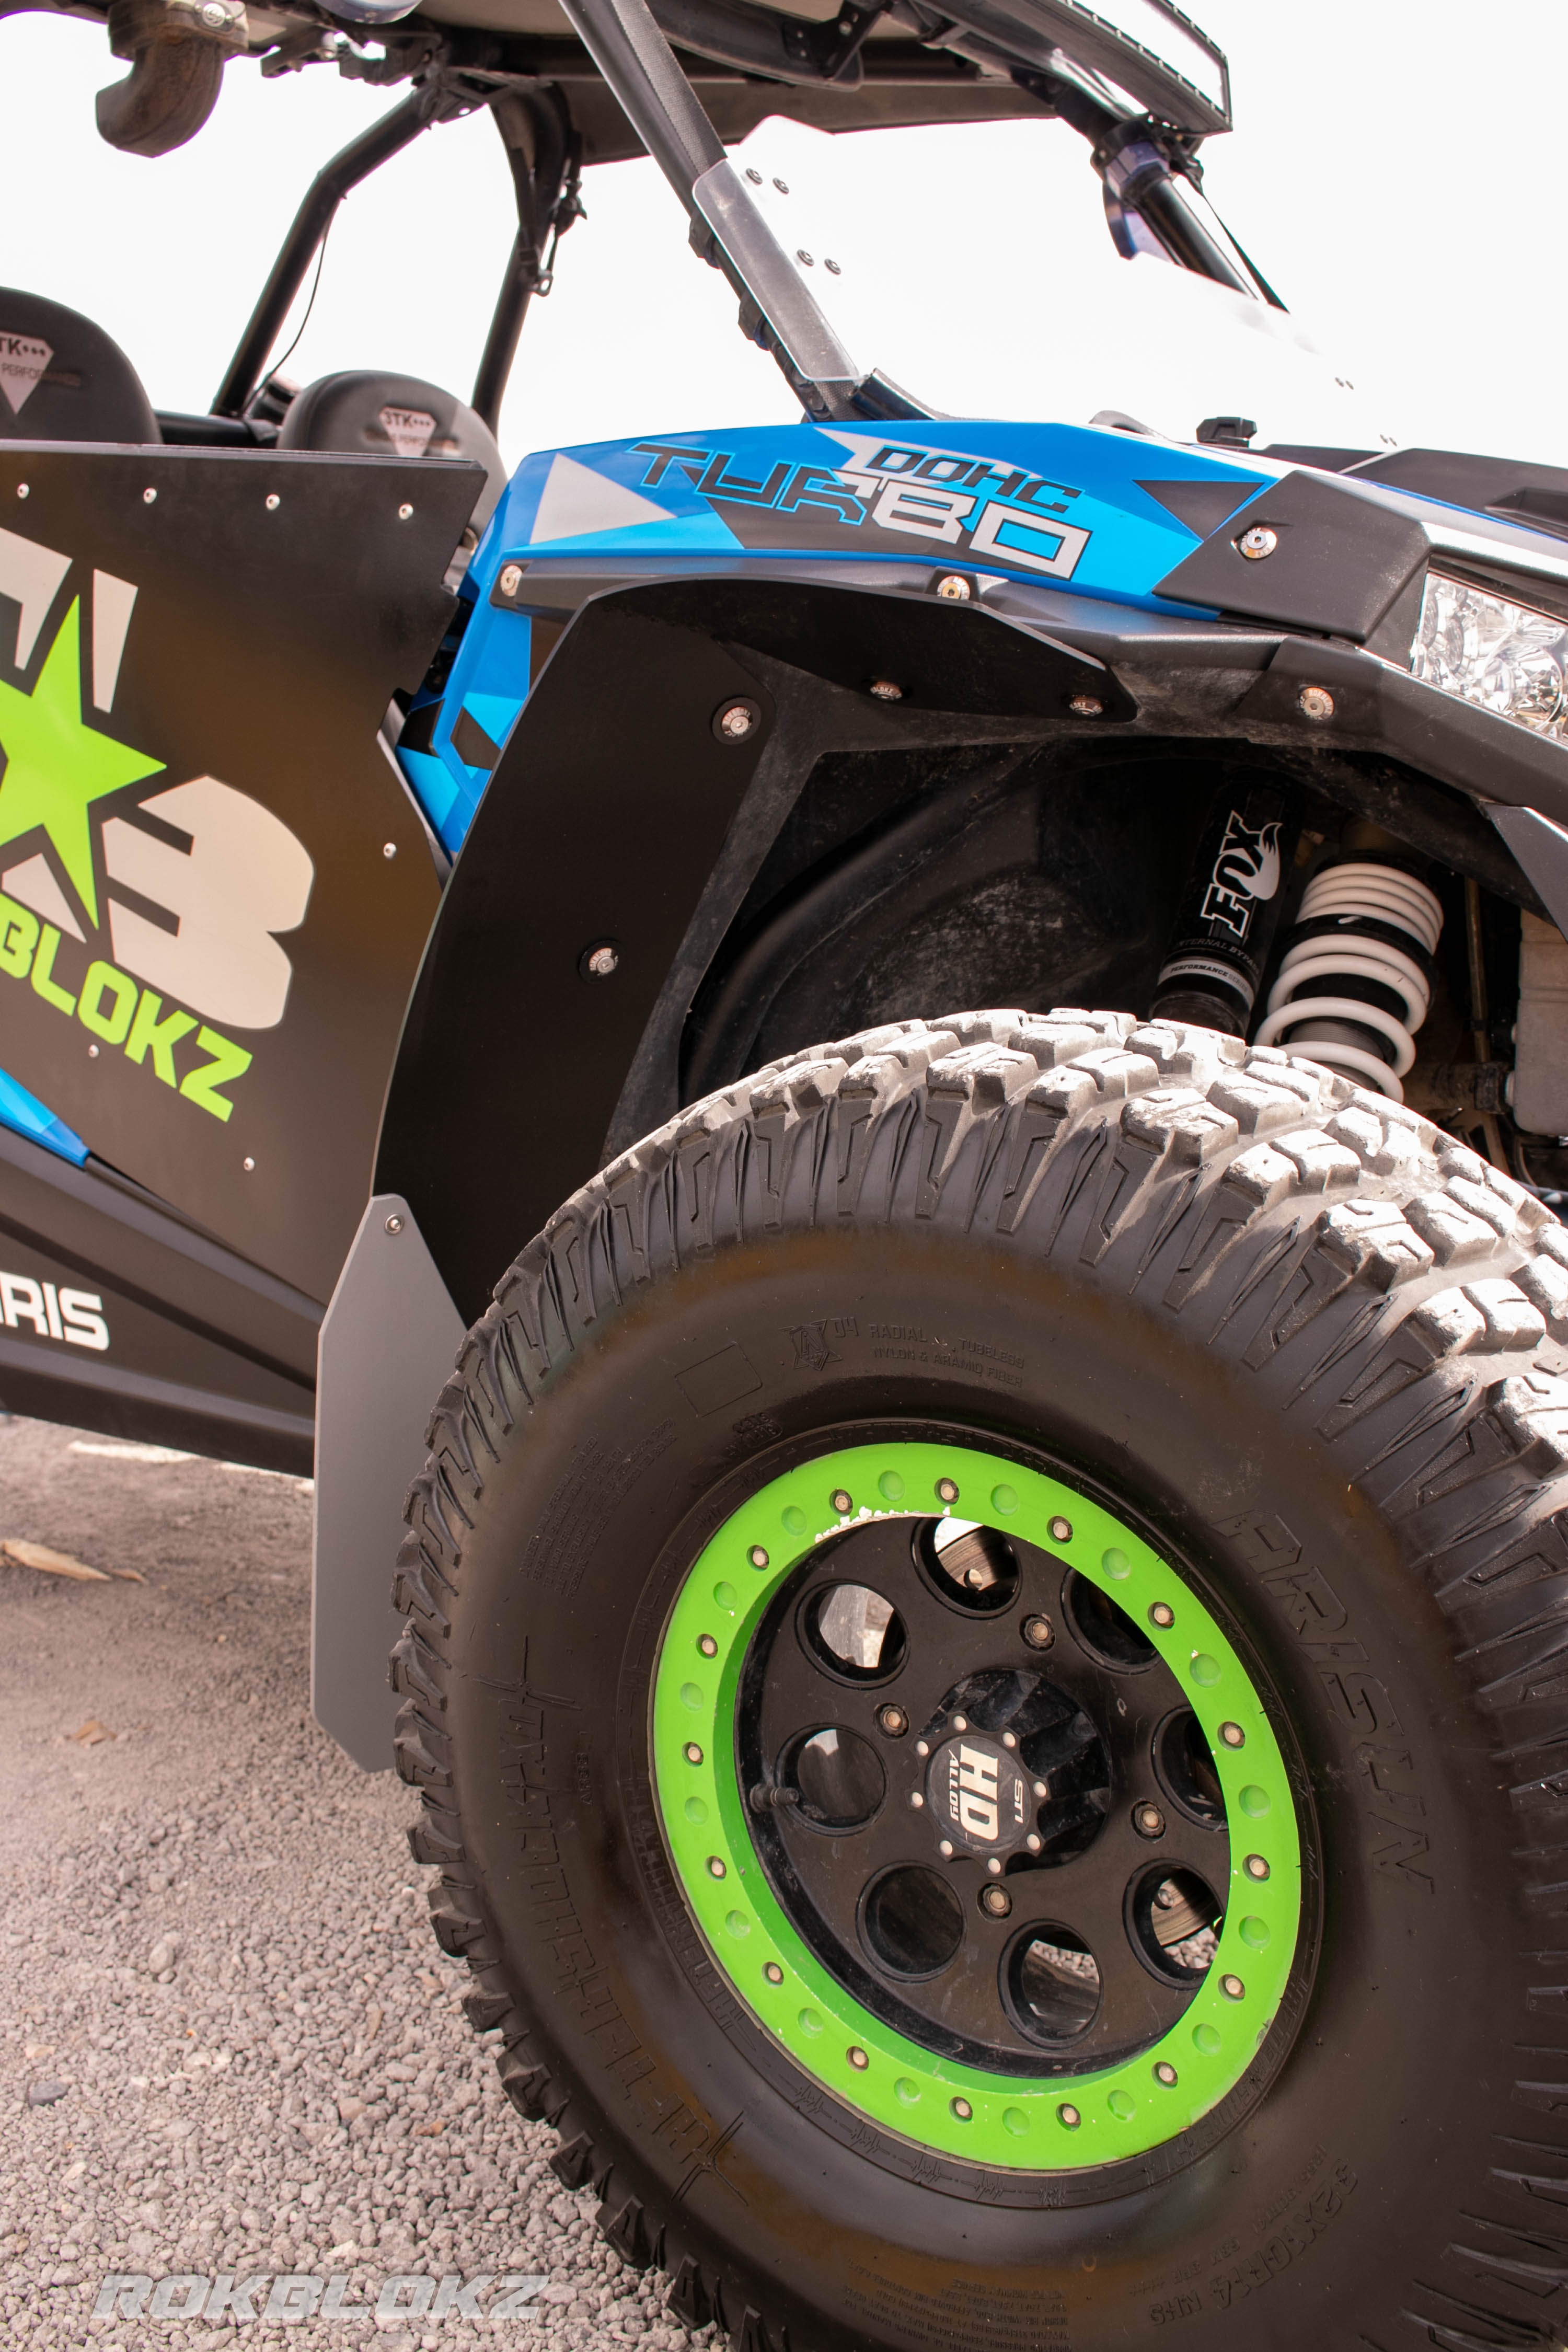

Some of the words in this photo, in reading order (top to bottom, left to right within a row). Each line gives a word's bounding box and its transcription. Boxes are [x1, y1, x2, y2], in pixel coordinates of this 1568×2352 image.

[627, 441, 1092, 581] TURBO
[864, 445, 1086, 514] DOHC
[1201, 810, 1283, 938] FOX
[0, 892, 253, 1122] BLOKZ
[1170, 964, 1229, 977] PERFORMANCE
[0, 1271, 110, 1351] RIS
[868, 1323, 928, 1343] RADIAL
[958, 1337, 1025, 1368] TUBELESS
[986, 1366, 1024, 1388] FIBER
[947, 1749, 960, 1822] ALLOY
[959, 1743, 999, 1841] HD
[1014, 1778, 1024, 1824] STI
